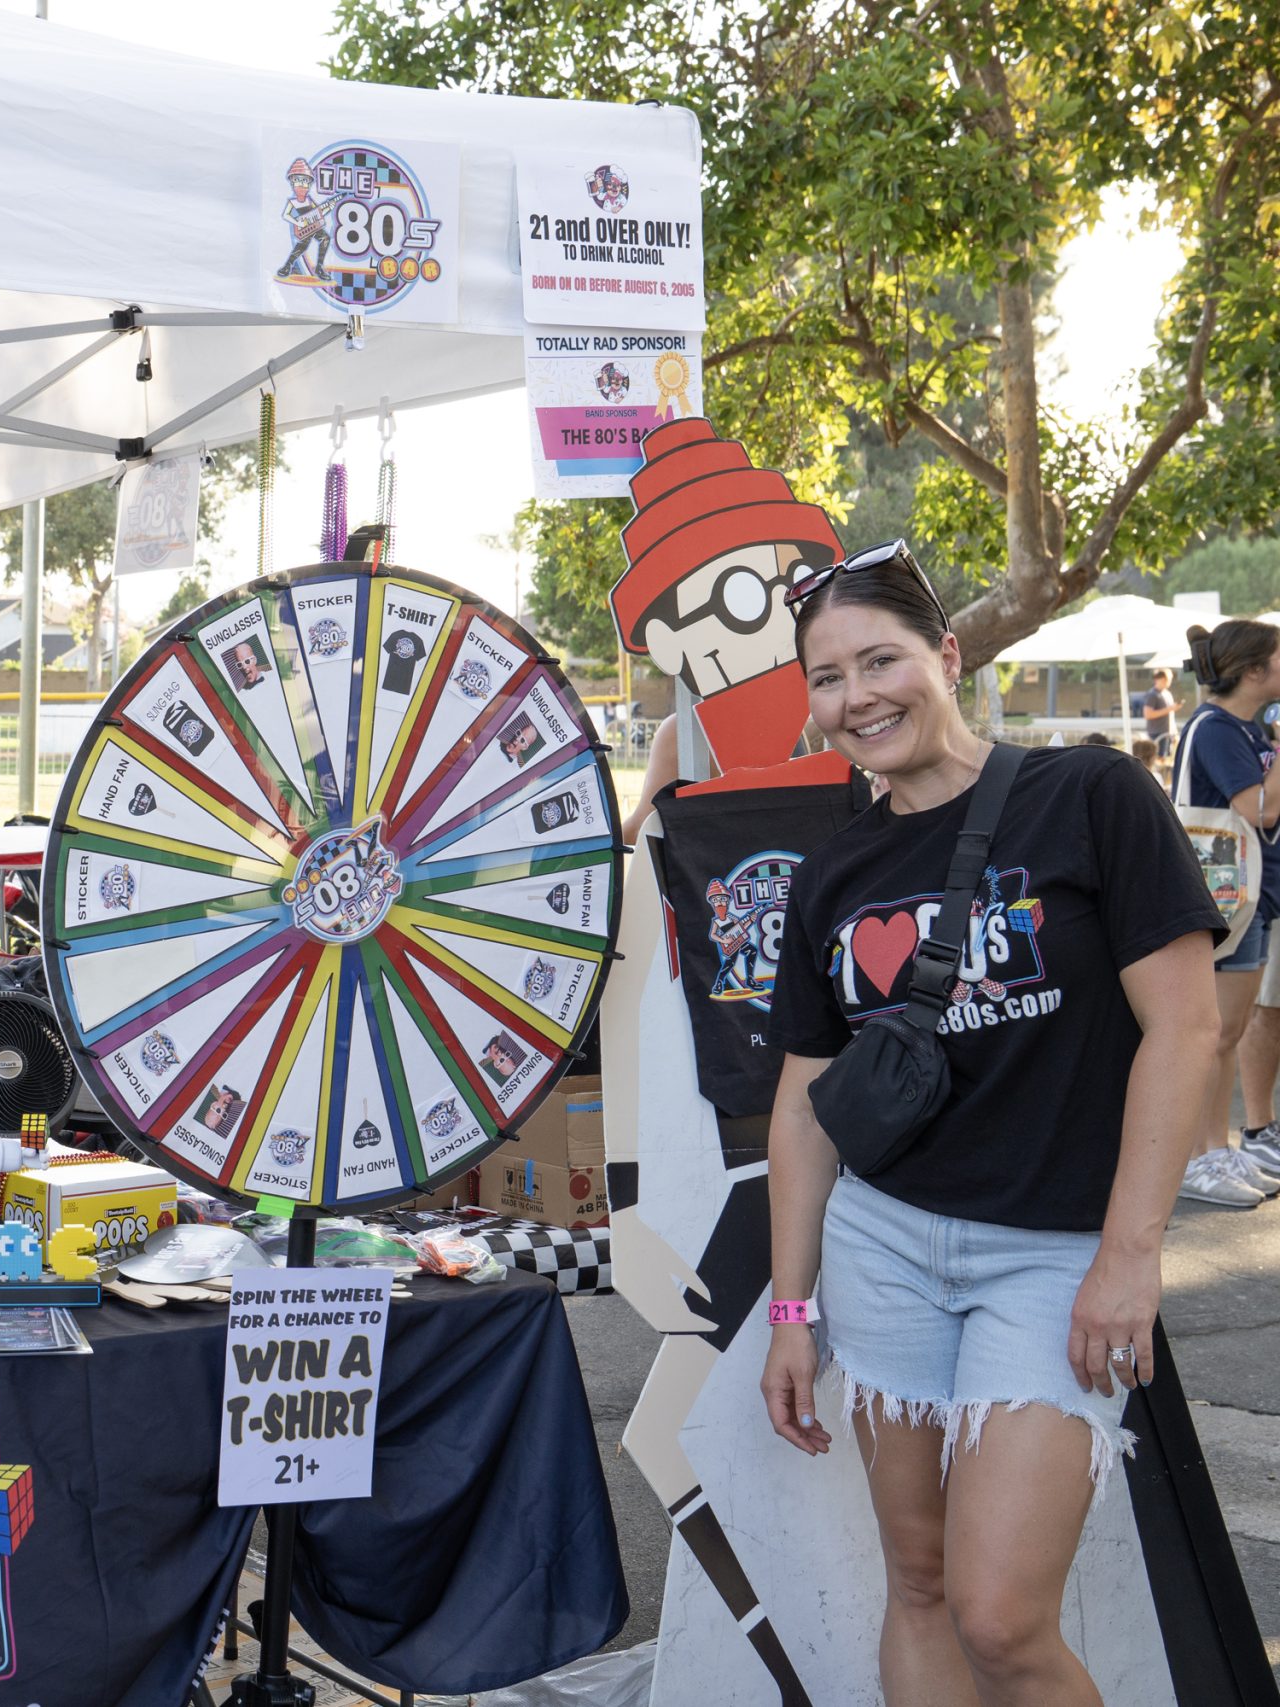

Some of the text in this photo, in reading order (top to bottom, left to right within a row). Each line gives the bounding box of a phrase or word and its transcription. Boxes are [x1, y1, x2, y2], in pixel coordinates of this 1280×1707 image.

[319, 167, 374, 197] THE
[530, 214, 691, 249] 21 and OVER ONLY!
[380, 258, 439, 279] BAR
[563, 244, 664, 265] TO DRINK ALCOHOL
[532, 275, 695, 297] BORN ON OR BEFORE AUGUST 6, 2005
[536, 336, 685, 351] TOTALLY RAD SPONSOR!
[585, 409, 637, 418] BAND SPONSOR
[561, 429, 590, 445] THE
[595, 428, 627, 444] 80'S
[298, 595, 353, 610] STICKER
[387, 603, 437, 627] T-SHIRT
[205, 610, 263, 650] SUNGLASSES
[467, 631, 514, 672] STICKER
[146, 681, 181, 722] SLING BAG
[530, 687, 568, 743] SUNGLASSES
[99, 759, 129, 819] HAND FAN
[577, 780, 595, 825] SLING BAG
[78, 856, 89, 920] STICKER
[581, 869, 593, 928] HAND FAN
[736, 880, 789, 905] THE
[838, 919, 861, 1005] I
[558, 964, 584, 1021] STICKER
[114, 1052, 151, 1104] STICKER
[498, 1051, 544, 1105] SUNGLASSES
[173, 1123, 226, 1167] SUNGLASSES
[430, 1127, 480, 1162] STICKER
[254, 1172, 308, 1189] STICKER
[343, 1157, 396, 1177] HAND FAN
[501, 1198, 519, 1208] MADE
[520, 1200, 525, 1209] IN
[526, 1202, 544, 1213] CHINA
[576, 1202, 594, 1215] 48
[93, 1215, 149, 1249] POPS
[232, 1288, 384, 1306] SPIN THE WHEEL
[772, 1304, 788, 1320] 21
[230, 1310, 381, 1329] FOR A CHANCE TO
[232, 1335, 372, 1384] WIN A
[227, 1388, 373, 1445] T-SHIRT
[274, 1454, 320, 1484] 21+
